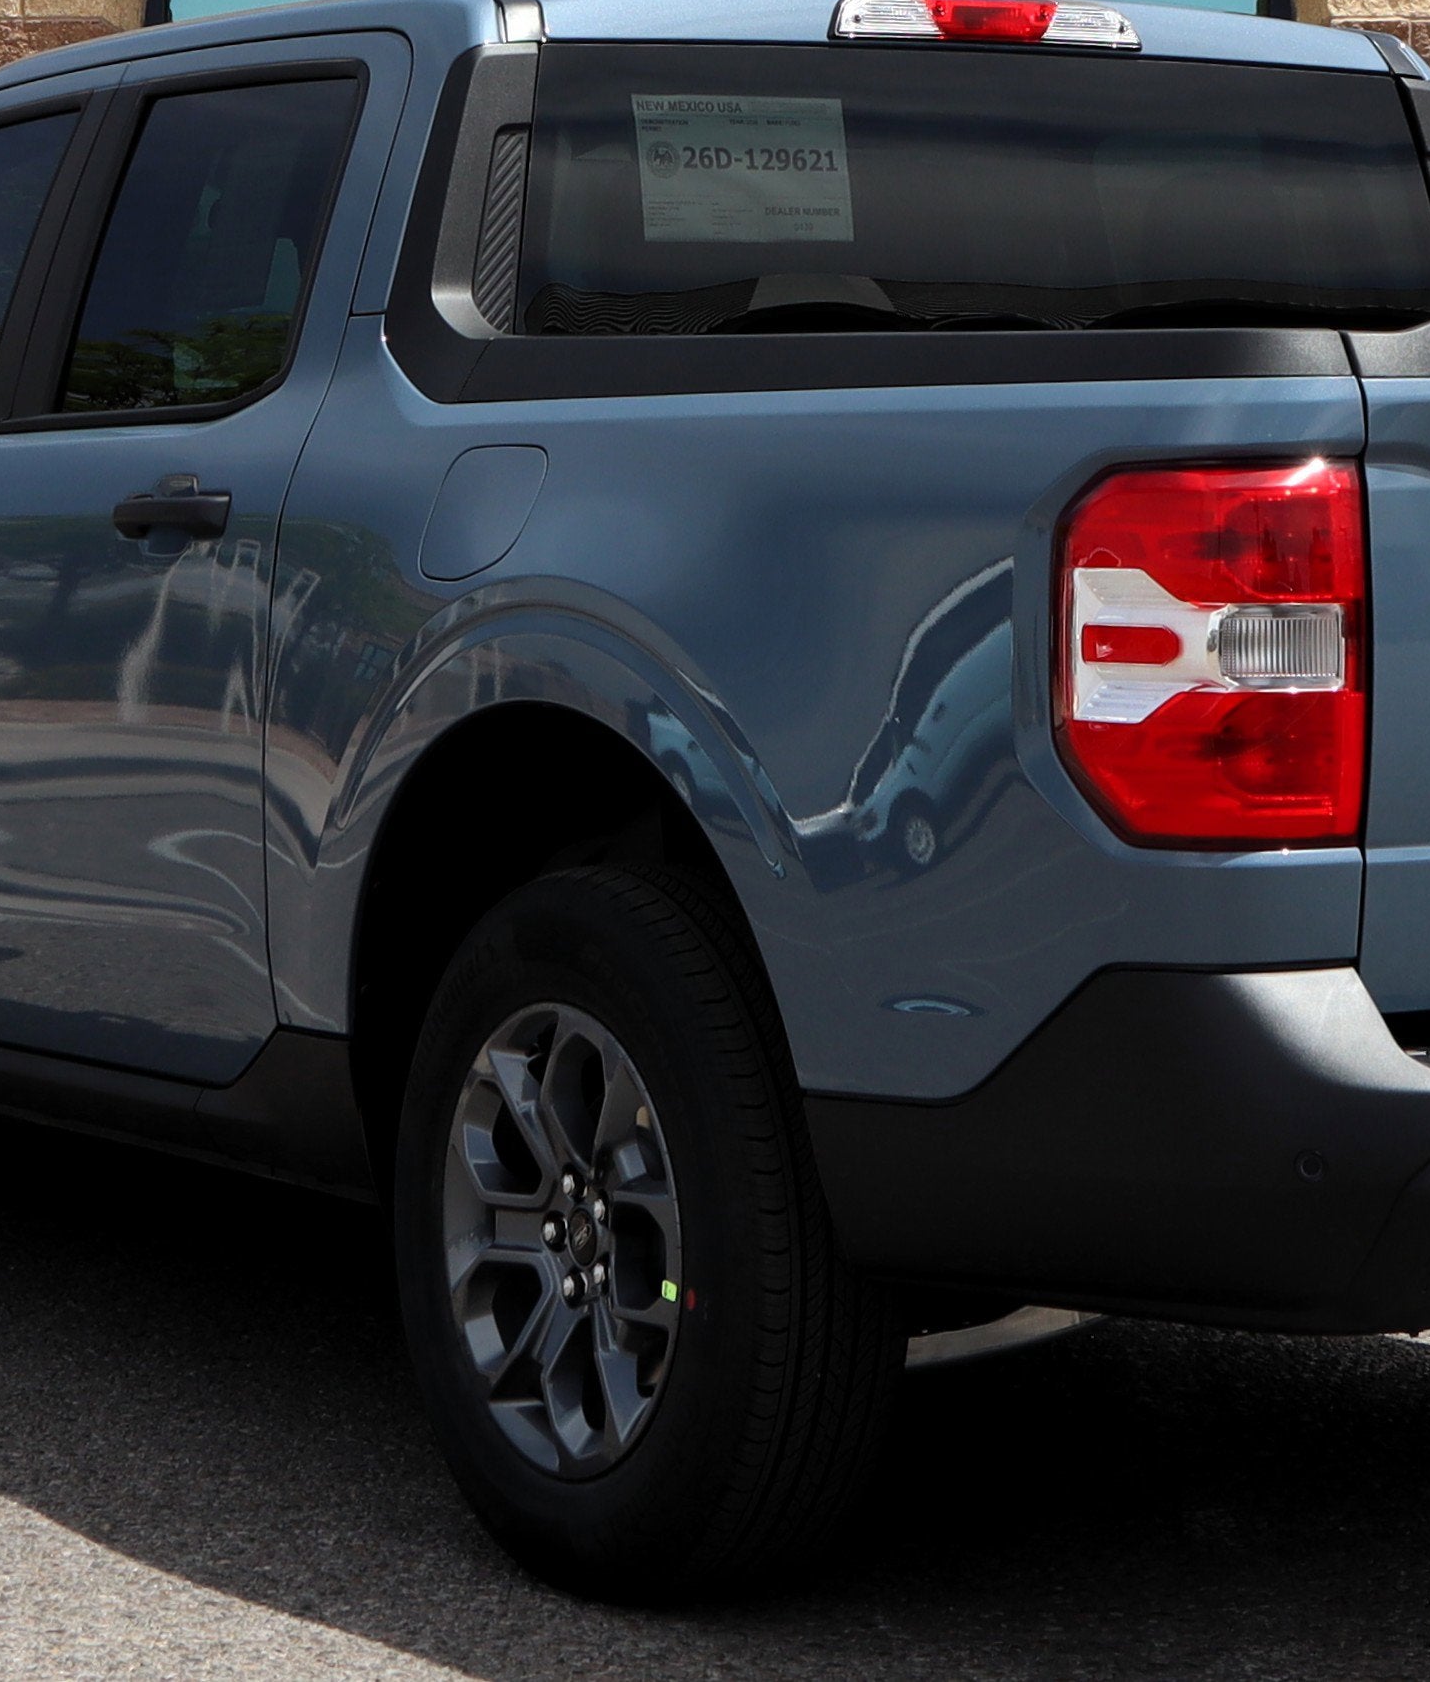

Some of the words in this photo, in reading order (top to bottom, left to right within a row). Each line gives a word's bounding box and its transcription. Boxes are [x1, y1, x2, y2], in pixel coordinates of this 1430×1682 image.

[636, 100, 665, 111] NEW
[668, 100, 715, 112] MEXICO
[717, 102, 743, 113] USA
[682, 146, 839, 172] 26D-129621
[765, 207, 802, 216] DEALER
[802, 207, 841, 217] NUMBER
